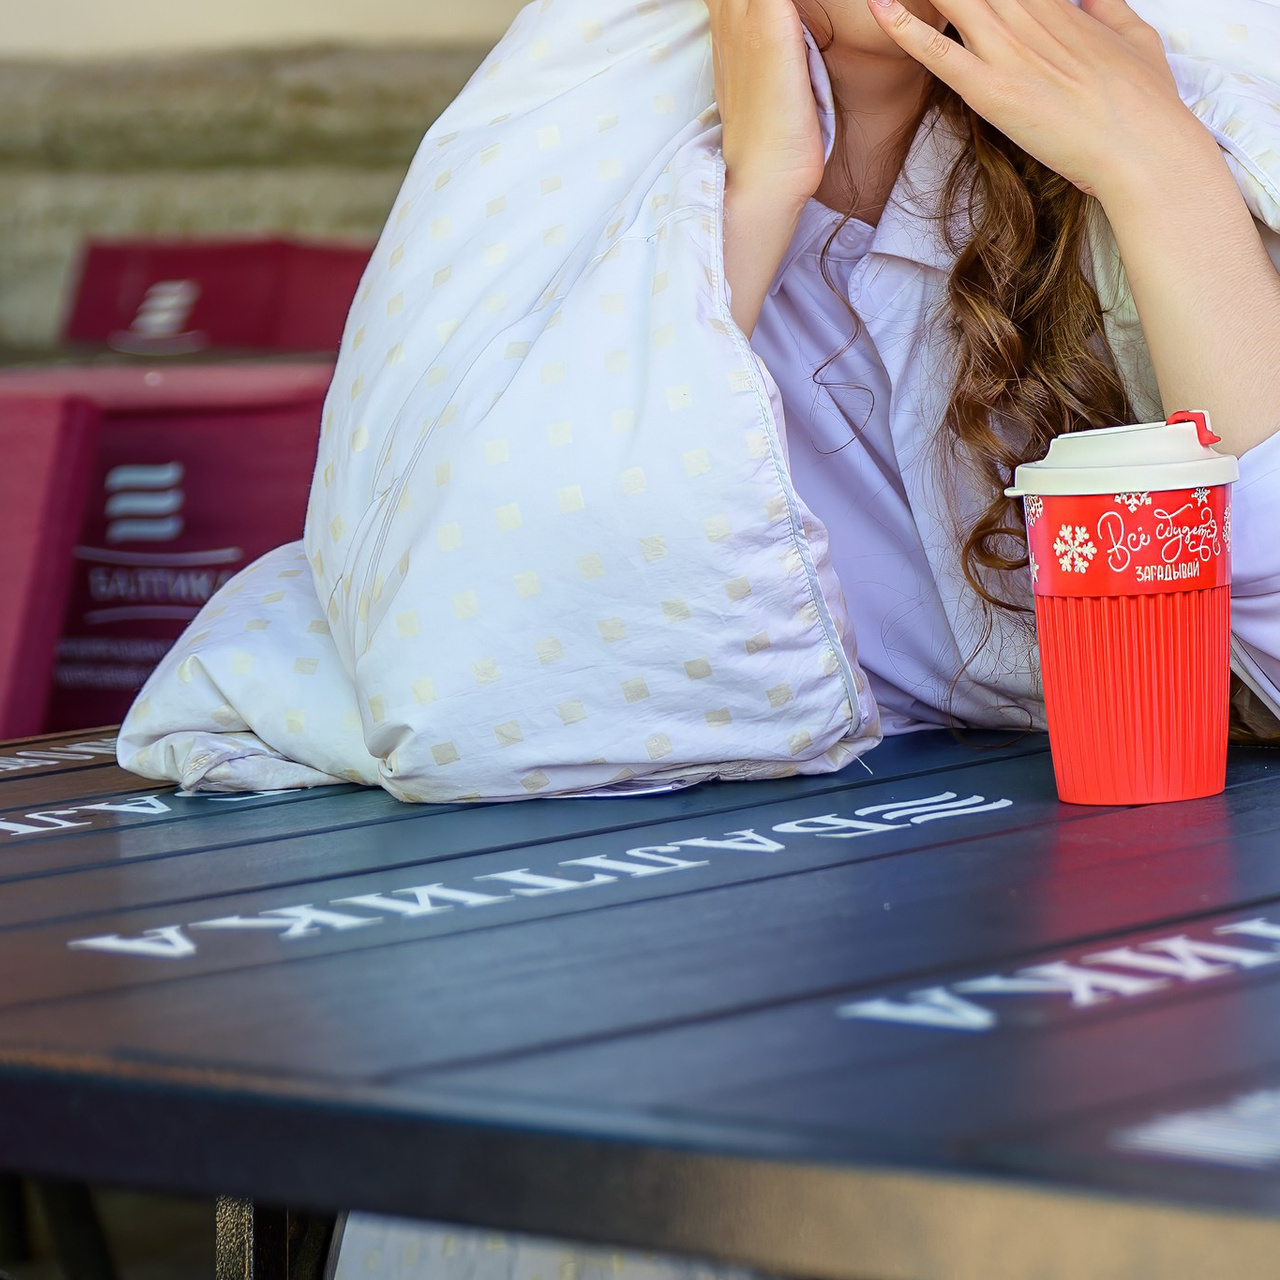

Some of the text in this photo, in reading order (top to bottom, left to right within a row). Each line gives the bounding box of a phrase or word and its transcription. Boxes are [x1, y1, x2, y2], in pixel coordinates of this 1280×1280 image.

[1097, 503, 1221, 573] Всё сбудется
[1135, 558, 1200, 582] ЗАГАДЫВАЙ
[66, 813, 912, 960] БАЛТИКА
